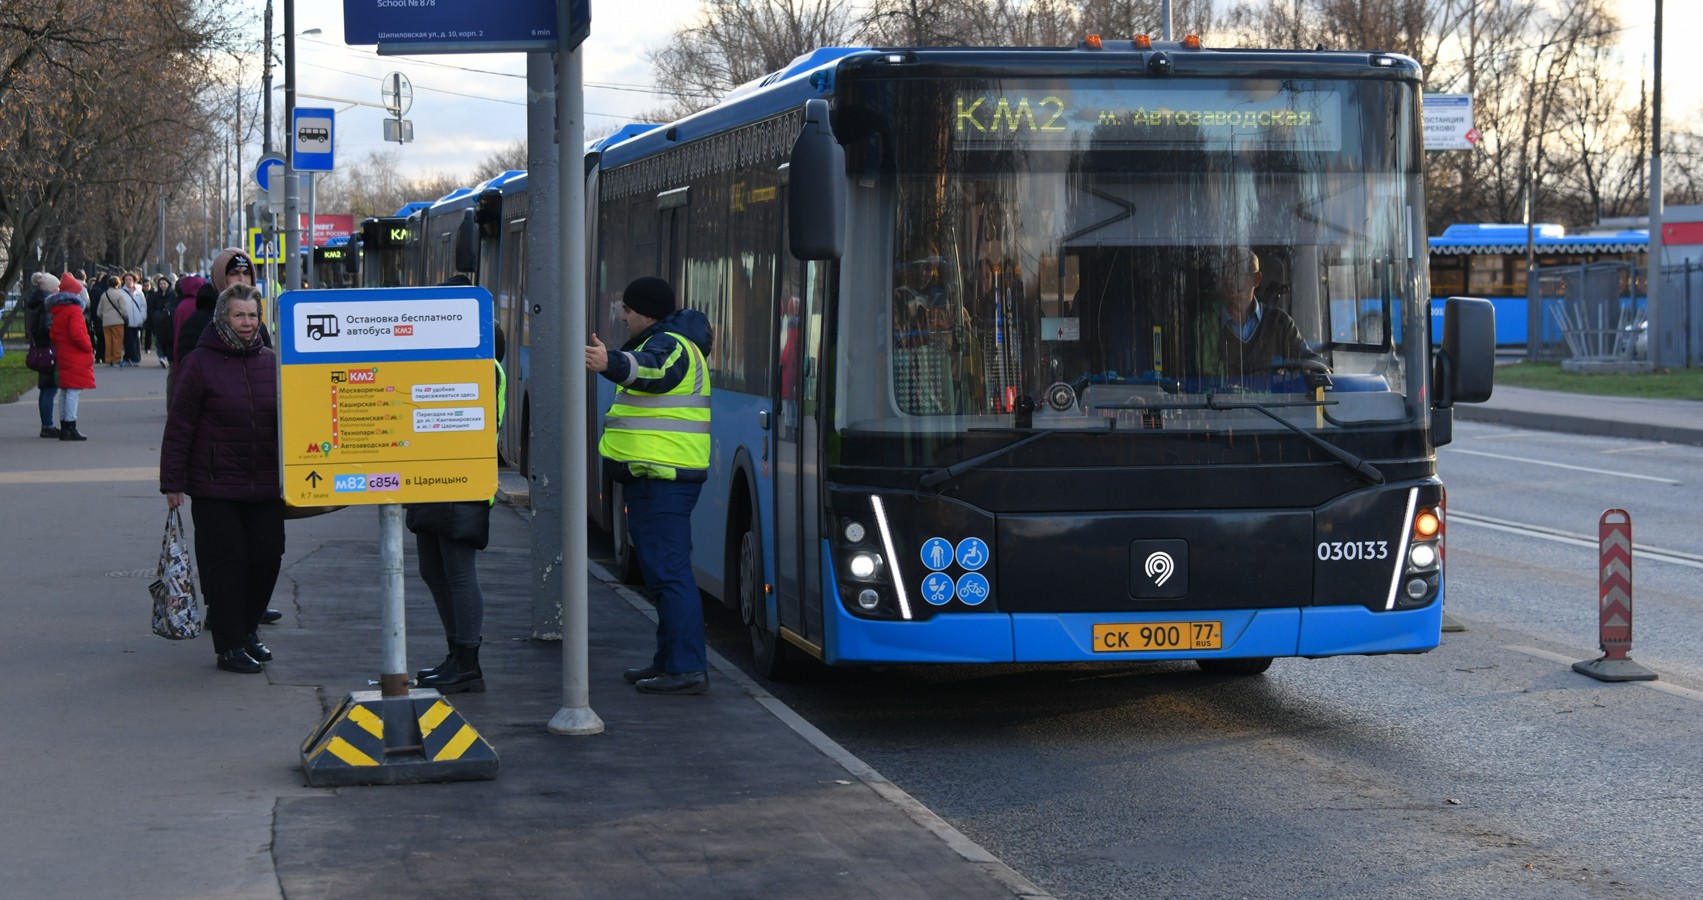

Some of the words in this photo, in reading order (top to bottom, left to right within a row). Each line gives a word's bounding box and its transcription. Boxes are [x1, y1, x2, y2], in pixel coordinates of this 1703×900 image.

[957, 96, 1066, 132] КМ2
[1097, 110, 1121, 126] м.
[1134, 107, 1312, 129] Автозаводская
[346, 315, 399, 324] Остановка
[401, 313, 463, 323] бесплатного
[346, 327, 391, 336] автобуса
[395, 327, 412, 335] КМ2
[350, 372, 375, 381] КМ2
[335, 476, 366, 490] м82
[369, 476, 400, 489] с854
[405, 478, 411, 486] в
[413, 476, 468, 486] Царицыно
[1317, 540, 1388, 561] 030133
[1140, 626, 1180, 647] 900
[1193, 624, 1213, 640] 77
